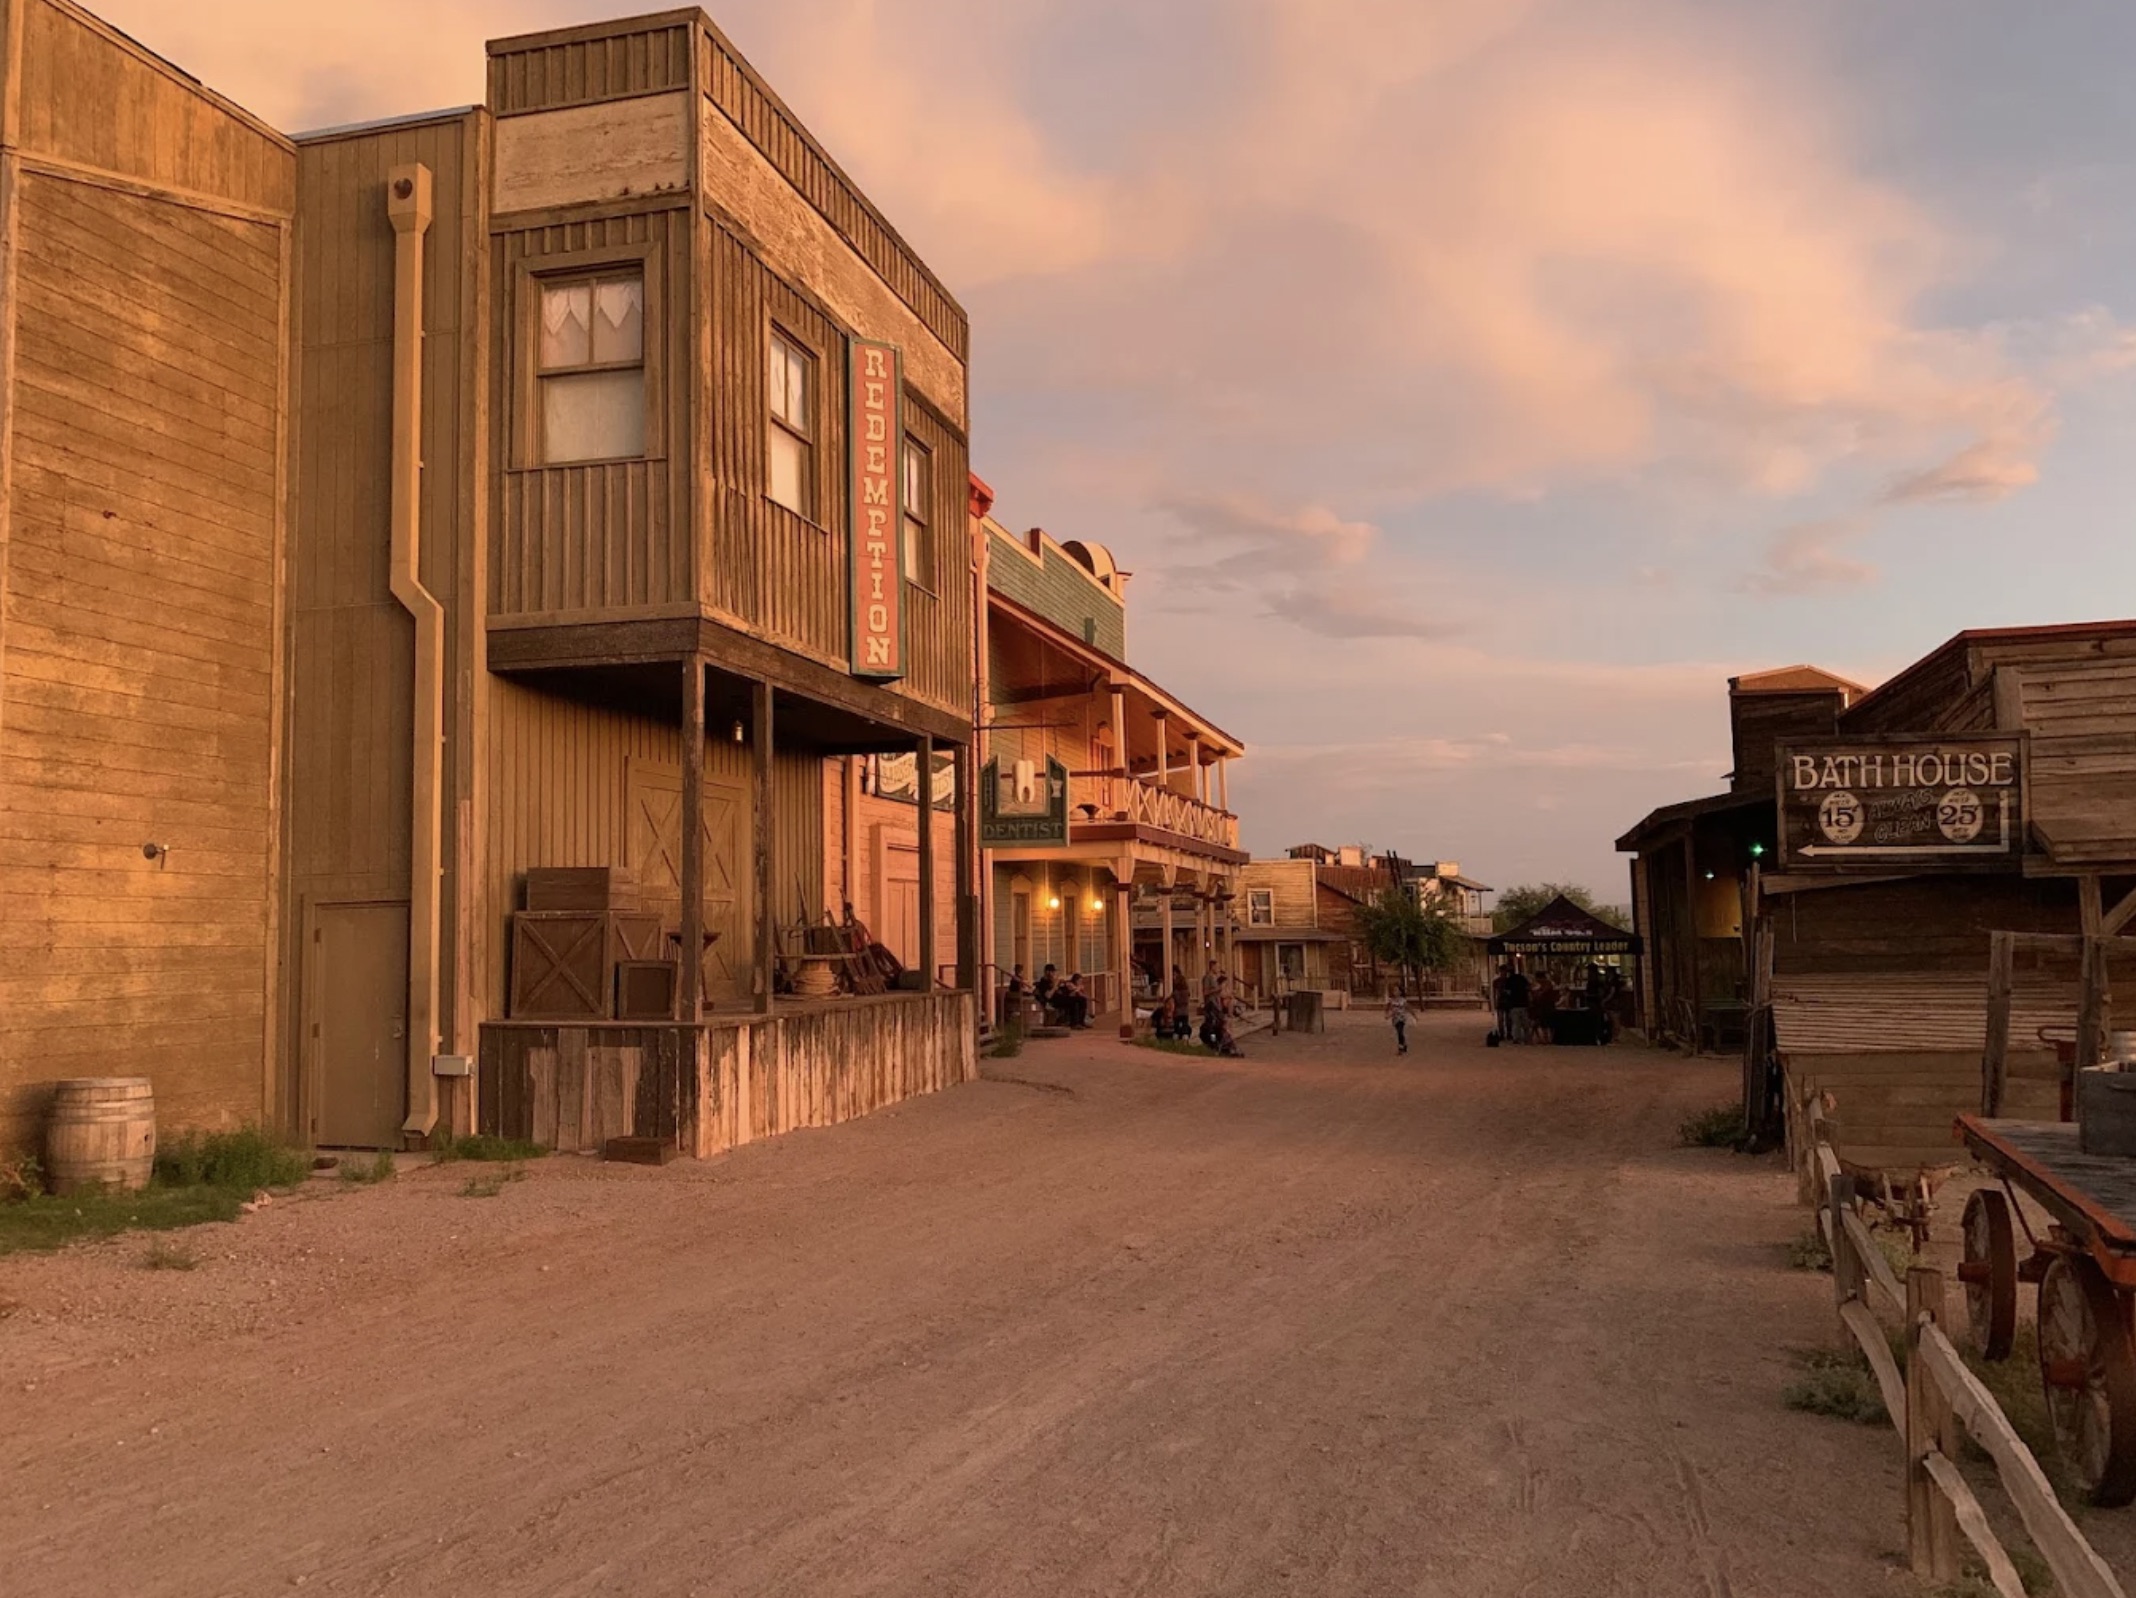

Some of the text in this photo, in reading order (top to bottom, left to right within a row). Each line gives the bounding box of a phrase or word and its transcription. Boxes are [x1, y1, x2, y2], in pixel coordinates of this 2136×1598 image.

[863, 349, 891, 665] REDEMPTION
[1792, 752, 2014, 789] BATH HOUSE
[1869, 788, 1934, 819] ALWAYS
[983, 822, 1063, 839] DENTIST
[1874, 810, 1931, 843] CLEAN
[1503, 941, 1629, 953] Tucson's Country Leader
